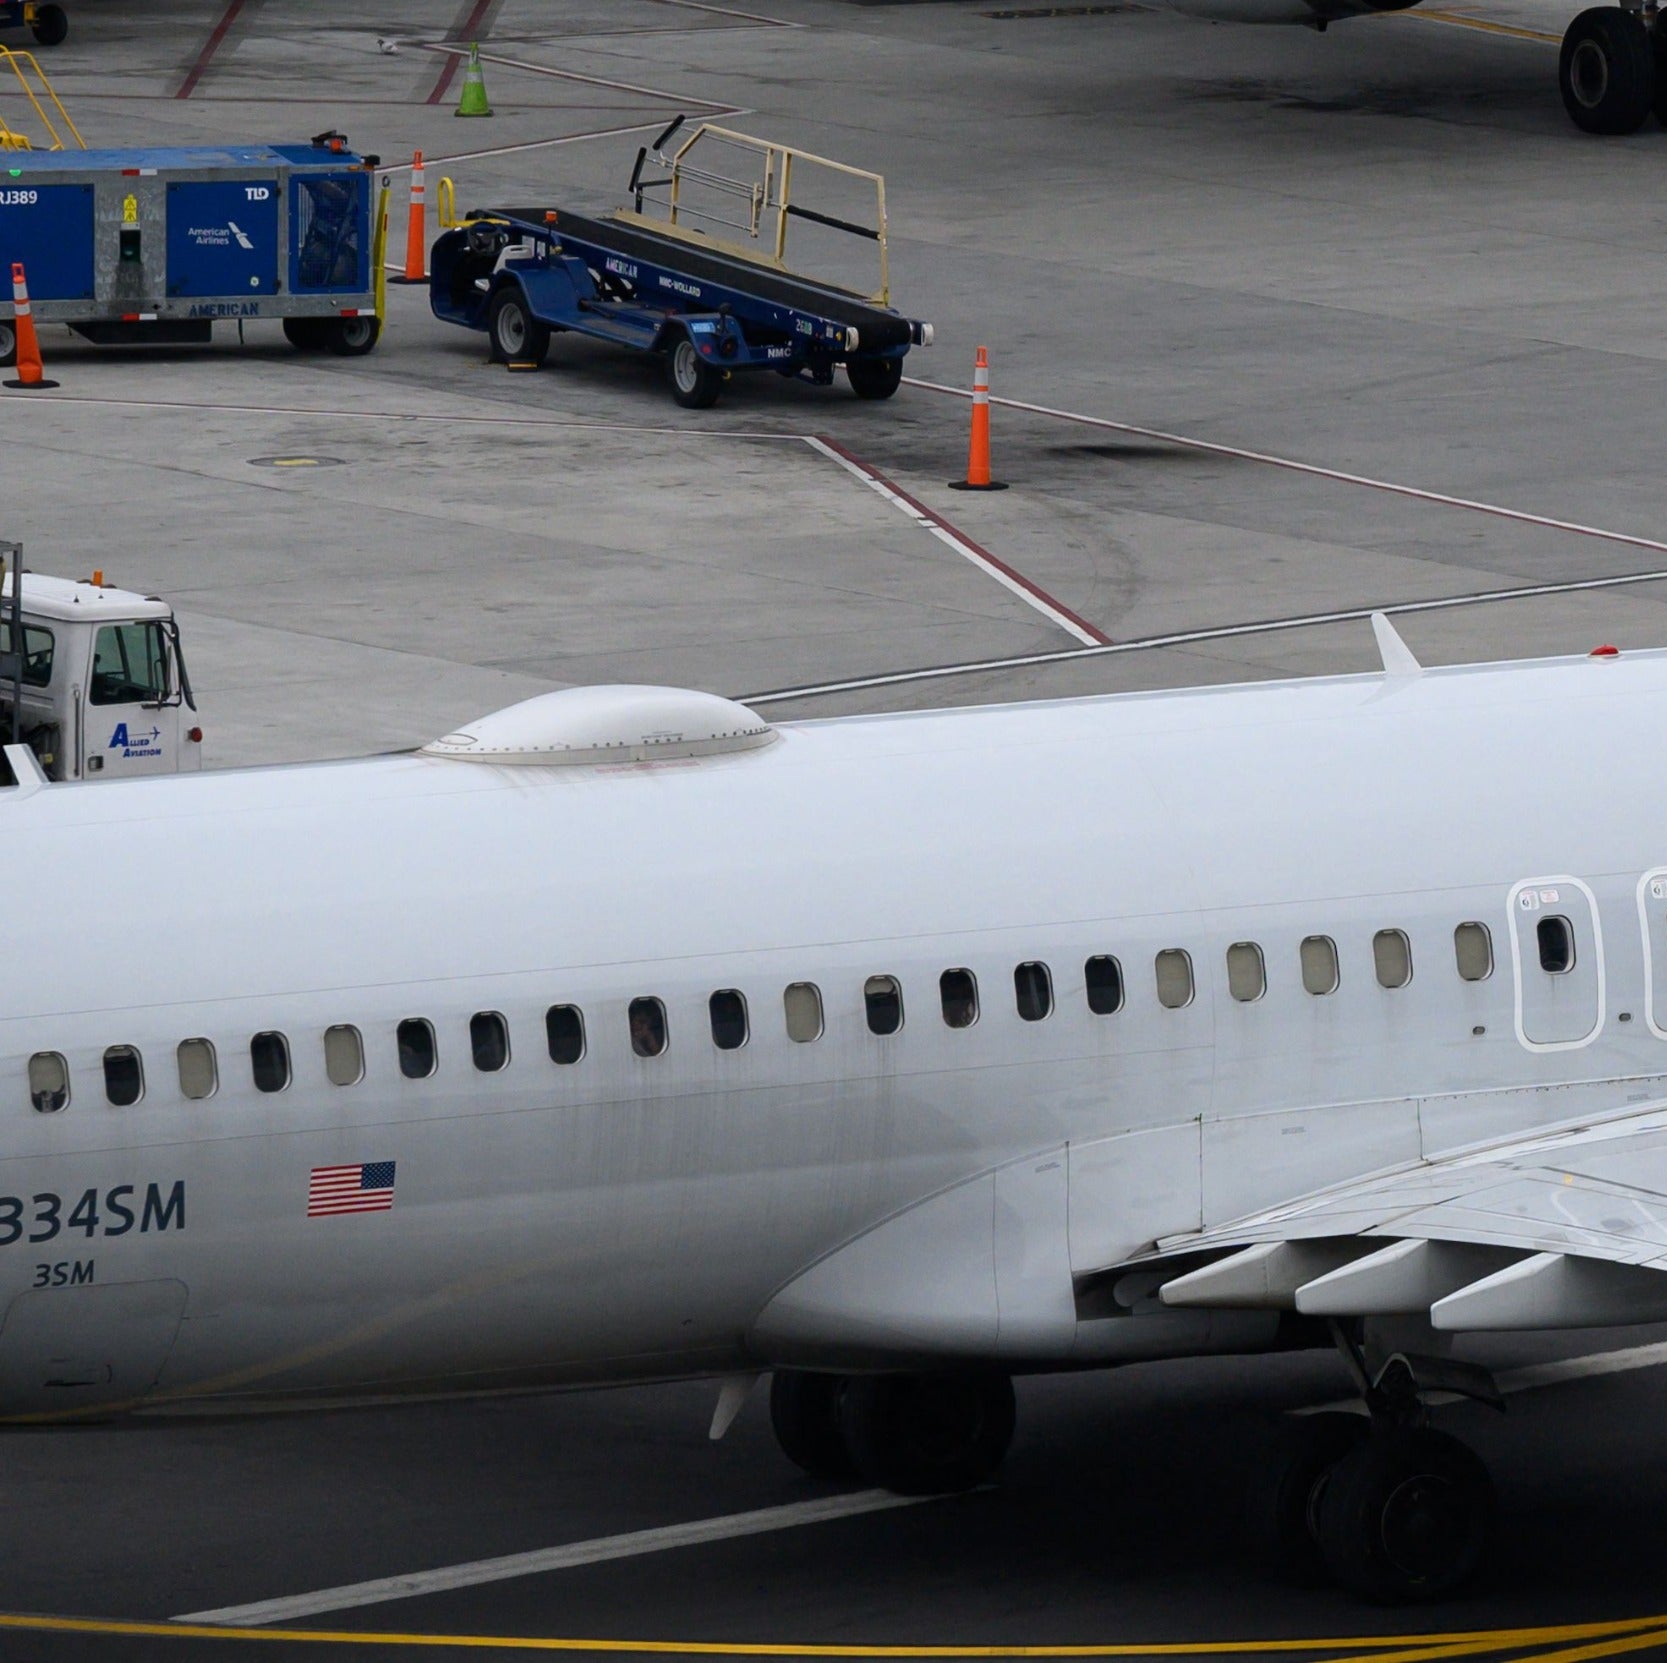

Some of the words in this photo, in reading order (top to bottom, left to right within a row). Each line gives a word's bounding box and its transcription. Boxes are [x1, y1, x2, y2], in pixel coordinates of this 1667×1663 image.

[244, 187, 270, 201] TLD
[187, 226, 230, 237] American
[195, 235, 230, 245] Airlines
[605, 256, 639, 279] AMERICAN
[658, 275, 702, 298] NMC-WOLLARD
[188, 302, 259, 317] AMERICAN
[767, 347, 792, 359] NMC
[33, 1259, 95, 1288] 3SM
